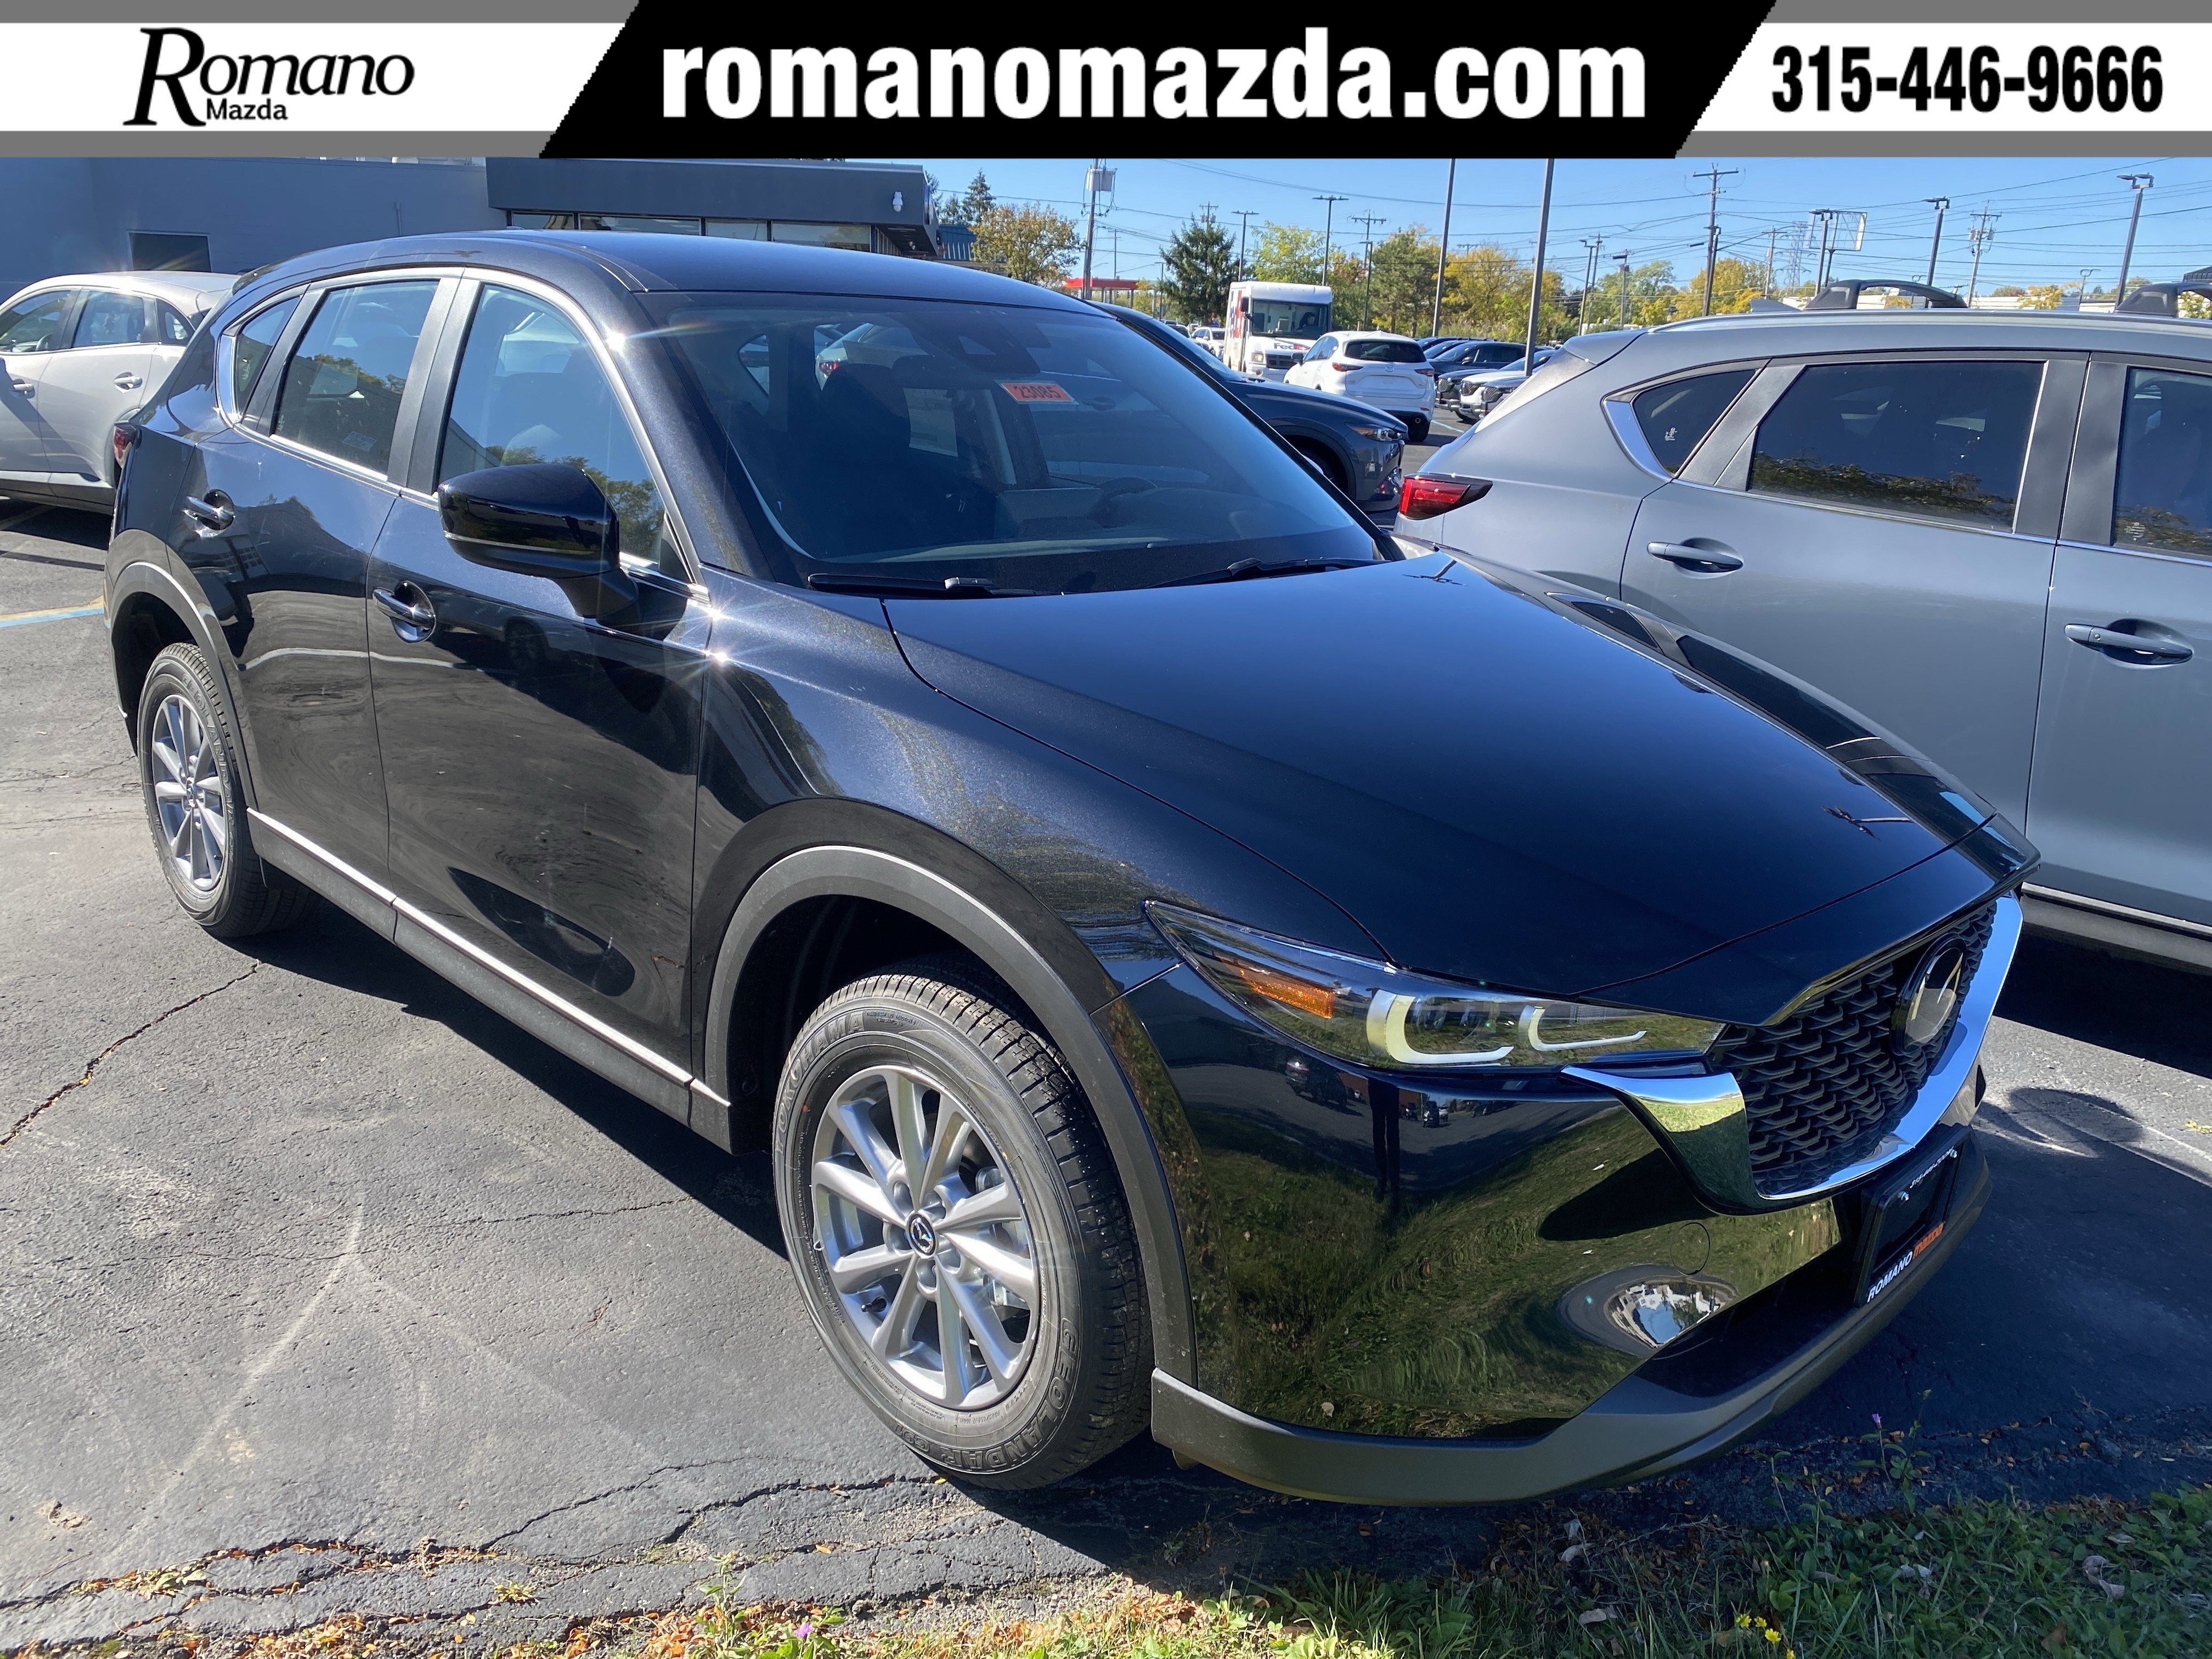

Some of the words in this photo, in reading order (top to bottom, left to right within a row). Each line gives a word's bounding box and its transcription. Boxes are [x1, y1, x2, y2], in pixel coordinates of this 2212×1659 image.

[775, 1012, 865, 1154] YOKOHAMA
[1867, 1251, 1913, 1303] ROMANO
[940, 1318, 1078, 1469] GEOLANDAR
